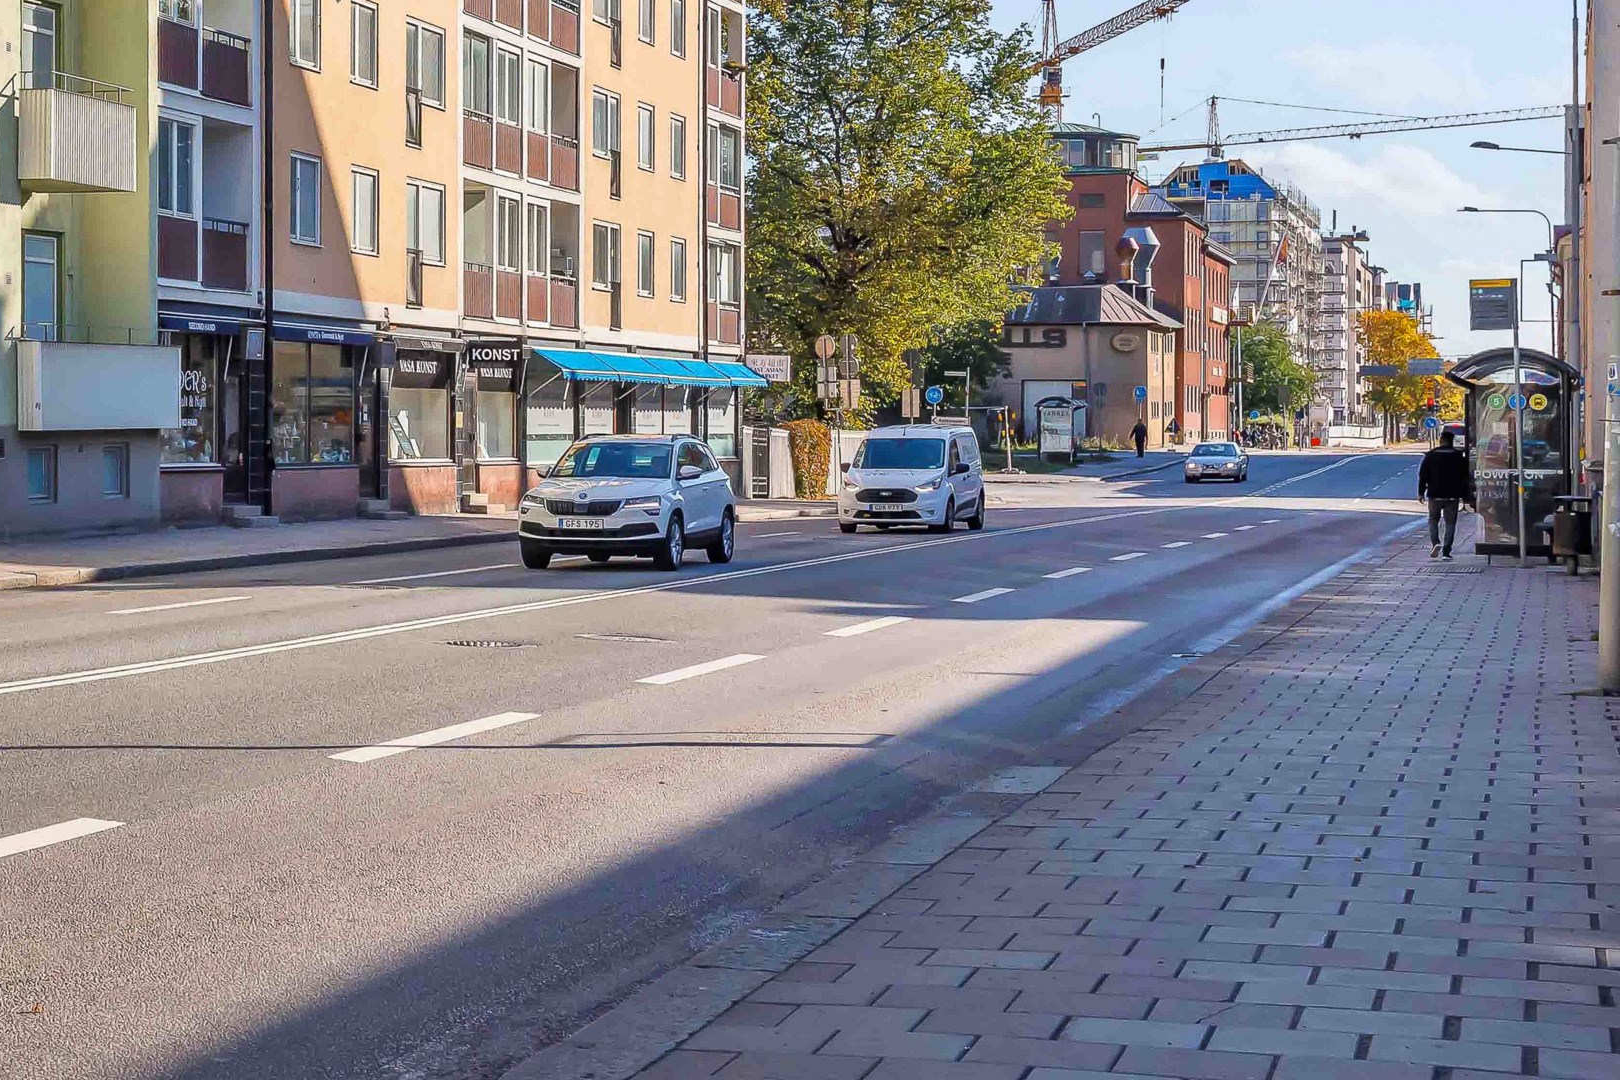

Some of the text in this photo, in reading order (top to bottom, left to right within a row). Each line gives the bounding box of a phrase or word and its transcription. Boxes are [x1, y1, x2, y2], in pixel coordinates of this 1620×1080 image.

[472, 348, 520, 361] KONST
[399, 359, 438, 374] VASA KONST
[480, 367, 513, 379] VASA KONST
[565, 520, 600, 528] GFS 195
